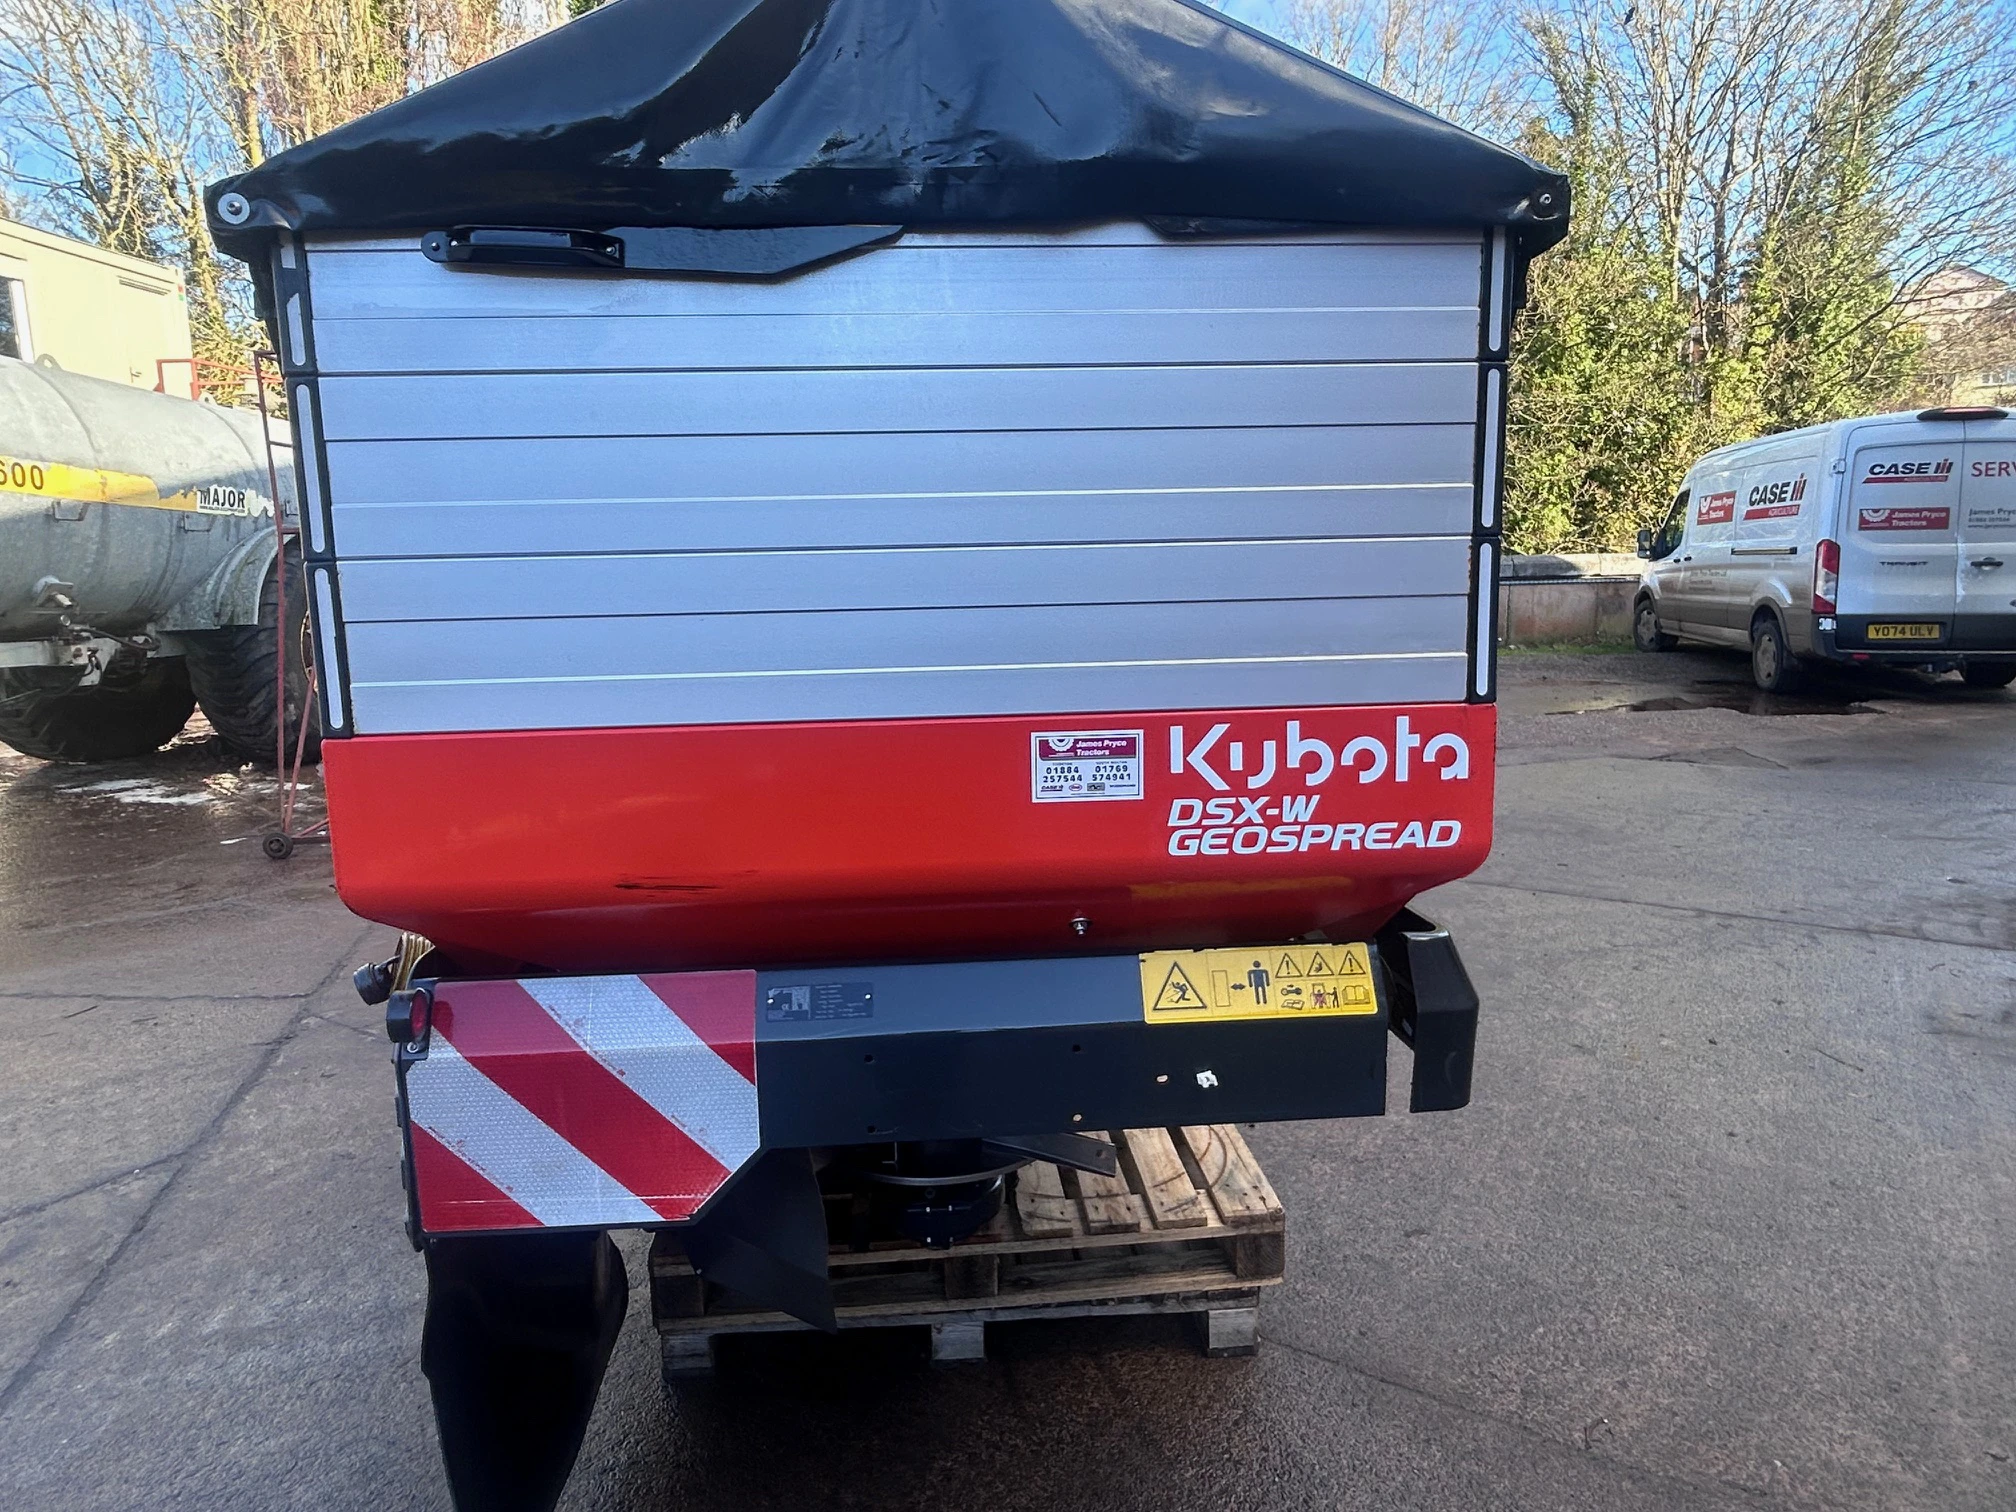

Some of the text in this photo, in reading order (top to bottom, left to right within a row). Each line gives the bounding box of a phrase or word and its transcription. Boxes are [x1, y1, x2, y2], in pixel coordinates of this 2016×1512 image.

[1869, 462, 1931, 475] CASE
[199, 487, 245, 508] MAJOR
[1749, 481, 1791, 507] CASE
[1076, 739, 1127, 749] James Pryce
[1076, 749, 1110, 757] Tractors
[1169, 715, 1470, 791] Kubota
[1046, 766, 1079, 775] 01884
[1095, 764, 1128, 773] 01769
[1043, 774, 1083, 783] 257544
[1092, 773, 1131, 782] 574941
[1167, 794, 1321, 827] DSX-W
[1167, 820, 1462, 856] GEOSPREAD
